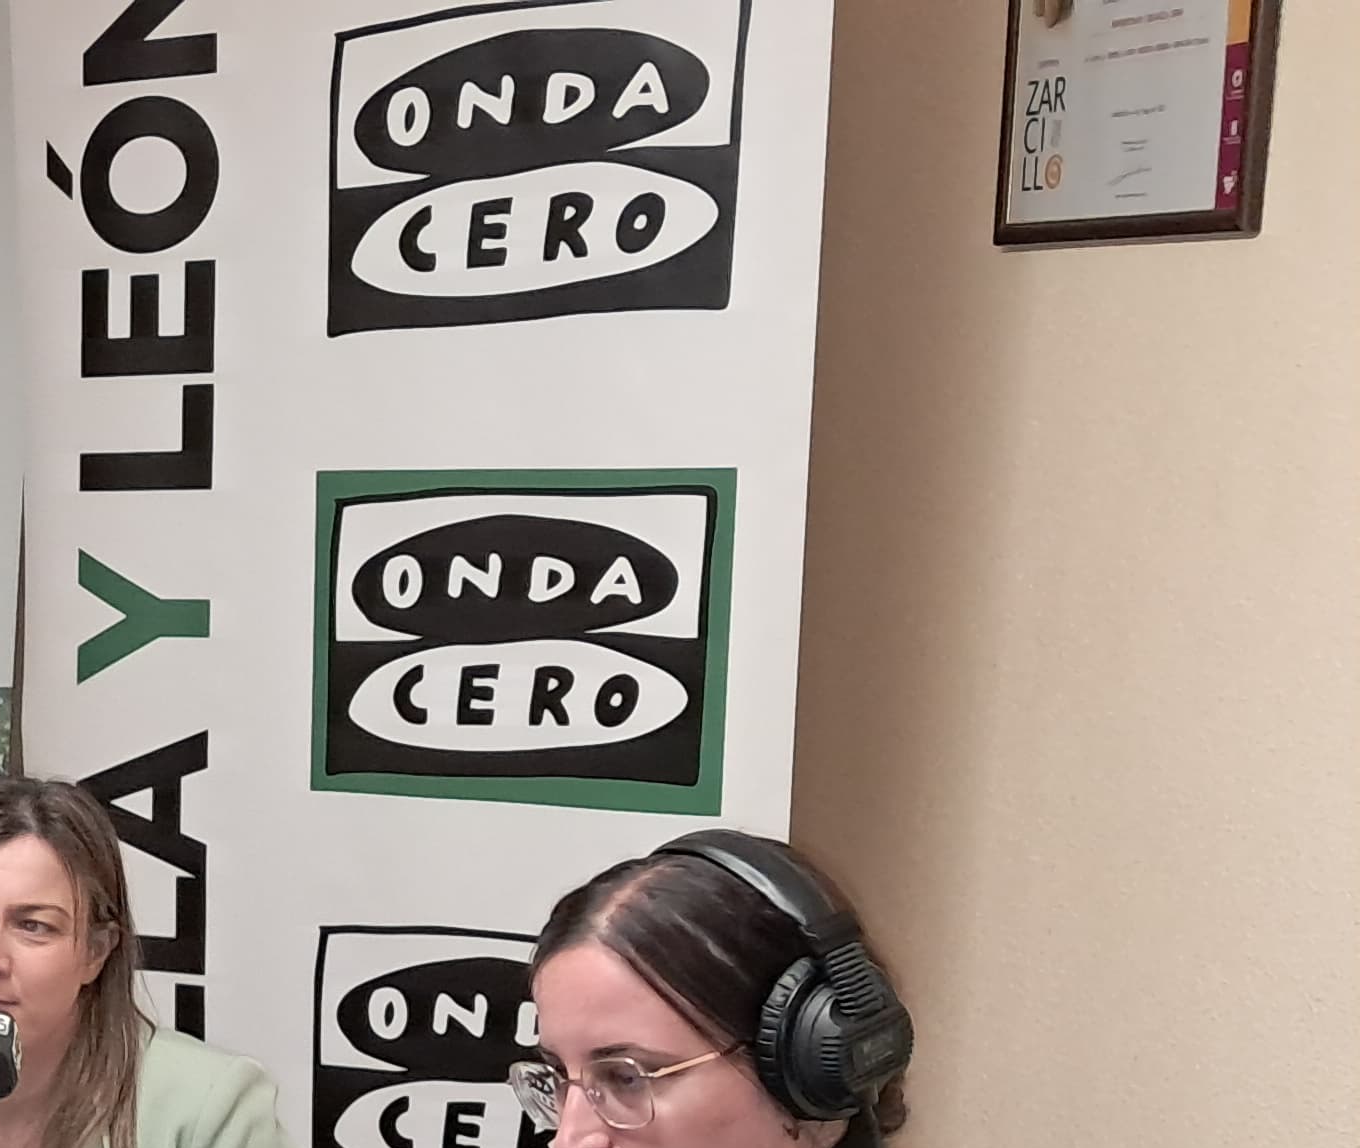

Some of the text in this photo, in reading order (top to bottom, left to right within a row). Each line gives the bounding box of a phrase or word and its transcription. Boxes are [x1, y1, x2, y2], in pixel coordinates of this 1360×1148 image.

[385, 61, 670, 147] ONDA
[1025, 76, 1066, 116] ZAR
[398, 191, 667, 273] CERO
[77, 548, 211, 686] Y
[382, 554, 642, 609] ONDA
[392, 664, 641, 728] CERO
